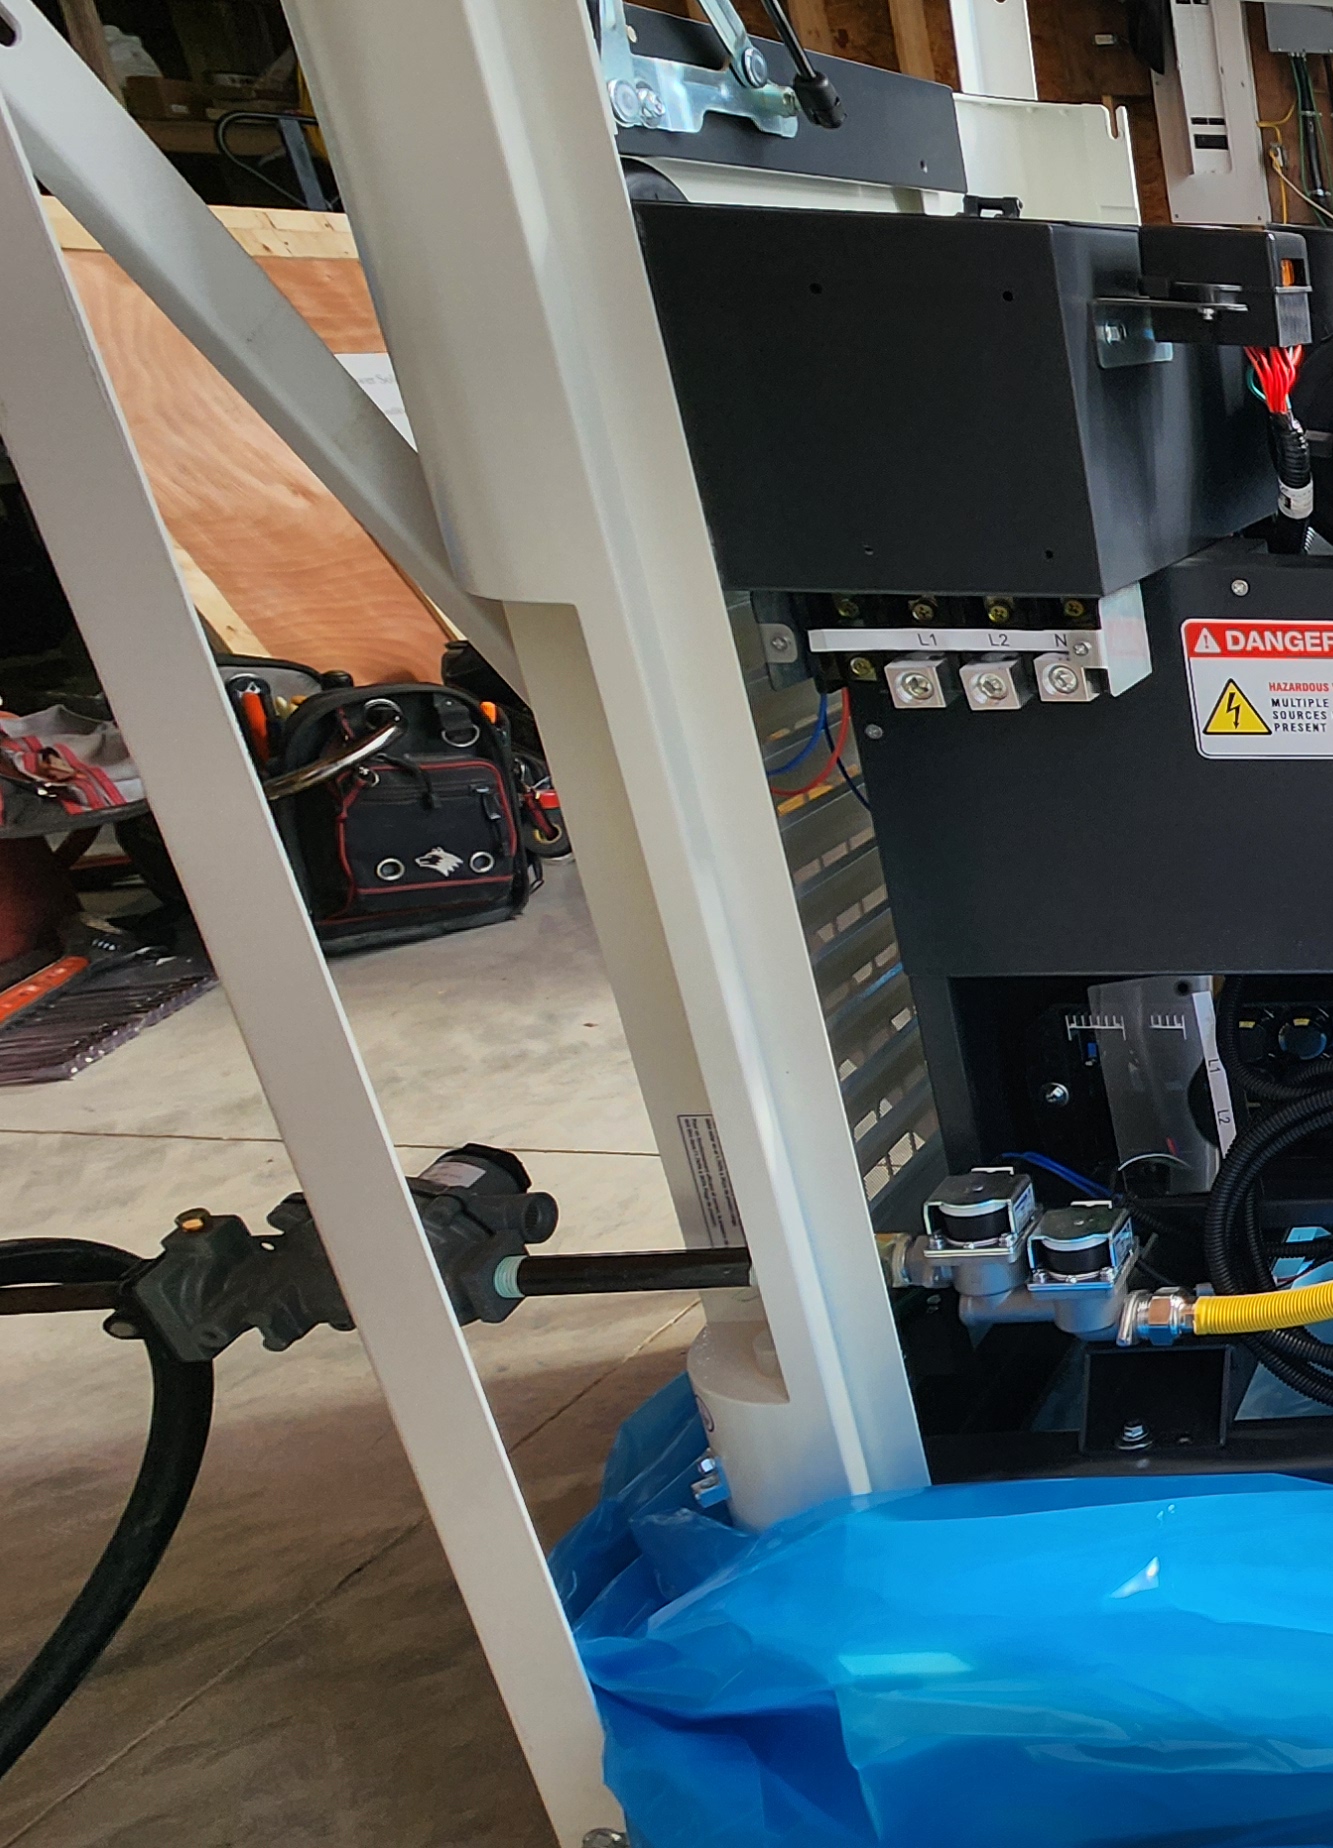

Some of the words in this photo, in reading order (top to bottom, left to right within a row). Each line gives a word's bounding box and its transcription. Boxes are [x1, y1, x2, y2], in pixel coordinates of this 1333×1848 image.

[917, 633, 938, 647] L1
[988, 633, 1010, 647] L2
[1053, 633, 1067, 647] N
[1268, 682, 1330, 692] HAZARDOUS
[1271, 698, 1330, 708] MULTIPLE
[1272, 710, 1328, 720] SOURCES
[1274, 722, 1327, 732] PRESENT
[1208, 1058, 1221, 1073] L1
[1217, 1109, 1231, 1125] L2
